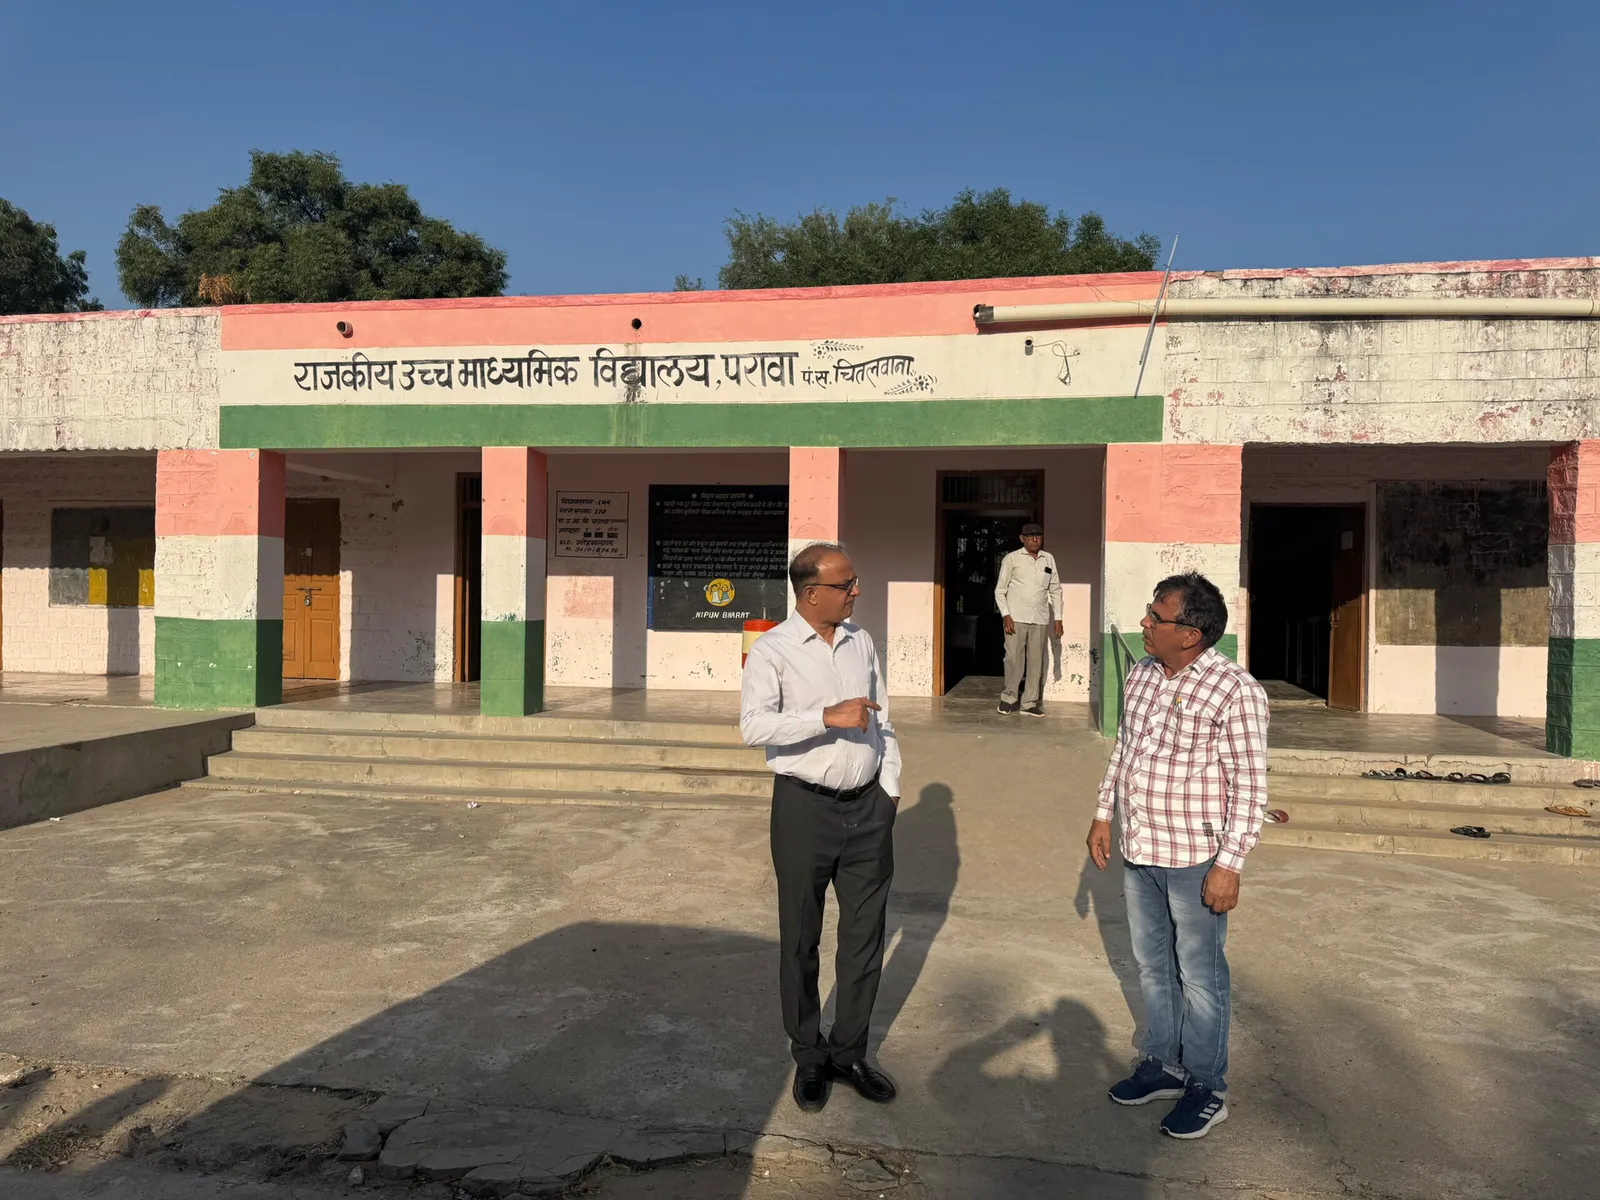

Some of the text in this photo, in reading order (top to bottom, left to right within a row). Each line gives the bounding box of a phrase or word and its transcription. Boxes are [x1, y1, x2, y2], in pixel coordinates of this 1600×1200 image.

[294, 352, 397, 391] राजकीय
[399, 358, 455, 391] उच्च
[458, 349, 580, 389] माध्यमिक
[721, 351, 799, 387] परावा
[834, 355, 916, 389] चितलवाना
[695, 611, 751, 619] NIPUN BHARAT
